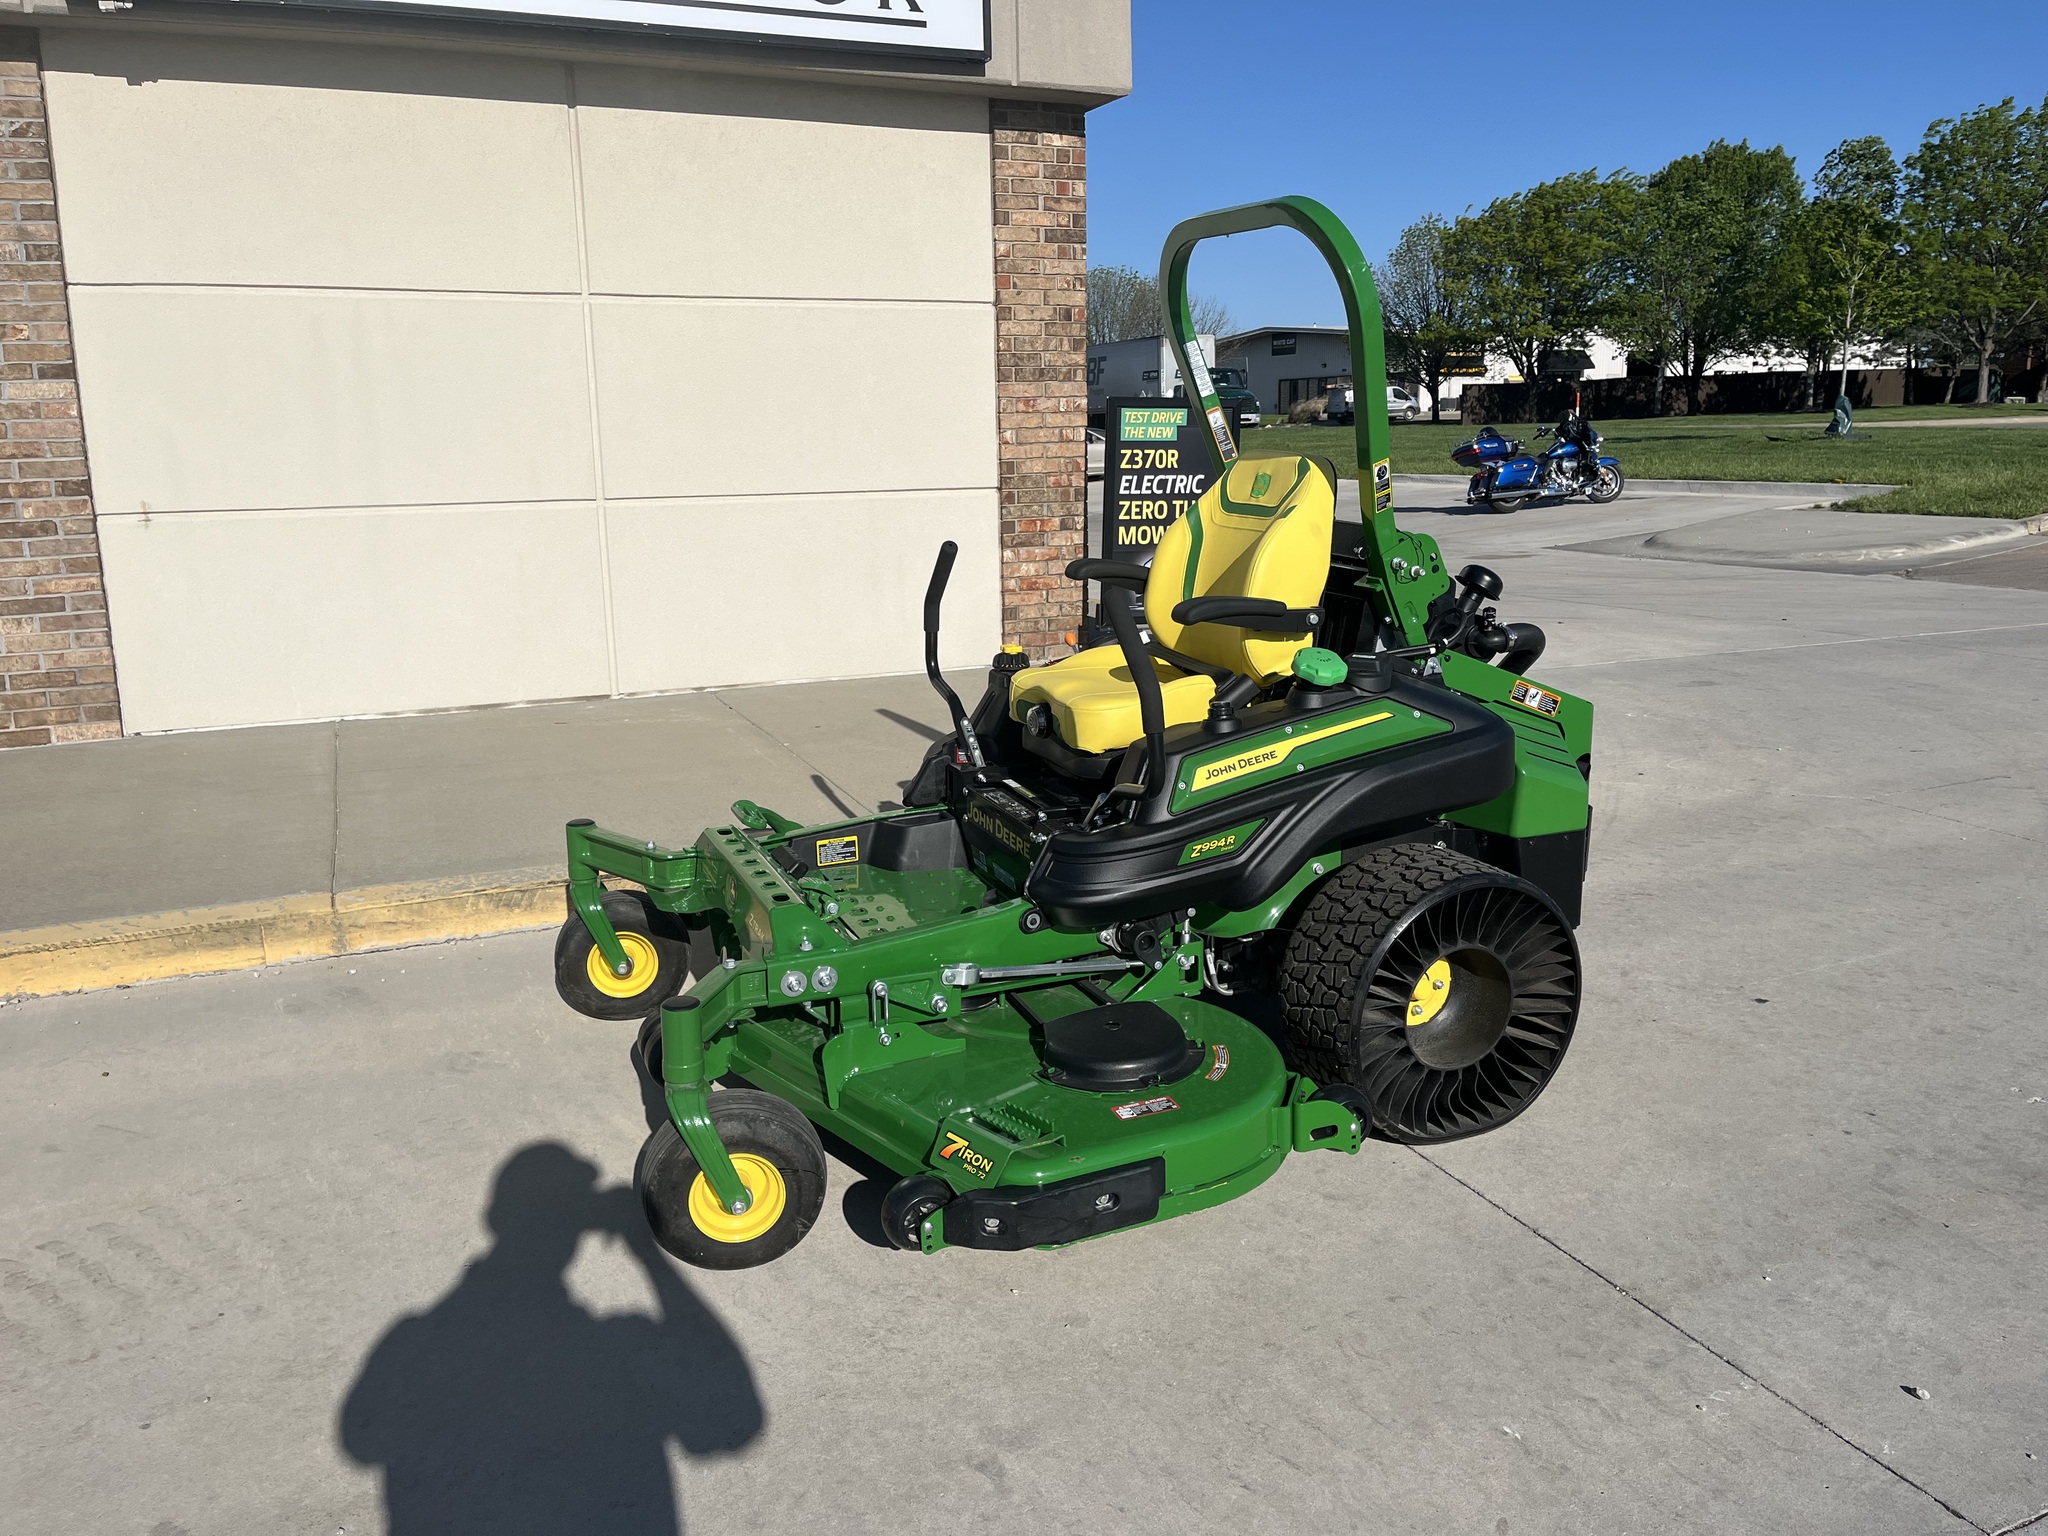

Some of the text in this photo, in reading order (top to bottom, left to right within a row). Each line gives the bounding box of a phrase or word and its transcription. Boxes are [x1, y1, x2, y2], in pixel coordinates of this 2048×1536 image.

[1124, 411, 1184, 424] TEST DRIVE
[1124, 426, 1174, 439] THE NEW
[1120, 449, 1179, 469] Z370R
[1119, 474, 1205, 494] ELECTRIC
[1119, 500, 1168, 520] ZERO
[1206, 750, 1278, 780] JOHN DEERE
[967, 802, 993, 834] JOHN
[995, 819, 1031, 860] DEERE
[1190, 835, 1235, 858] Z994R
[963, 1163, 986, 1180] PRO 72
